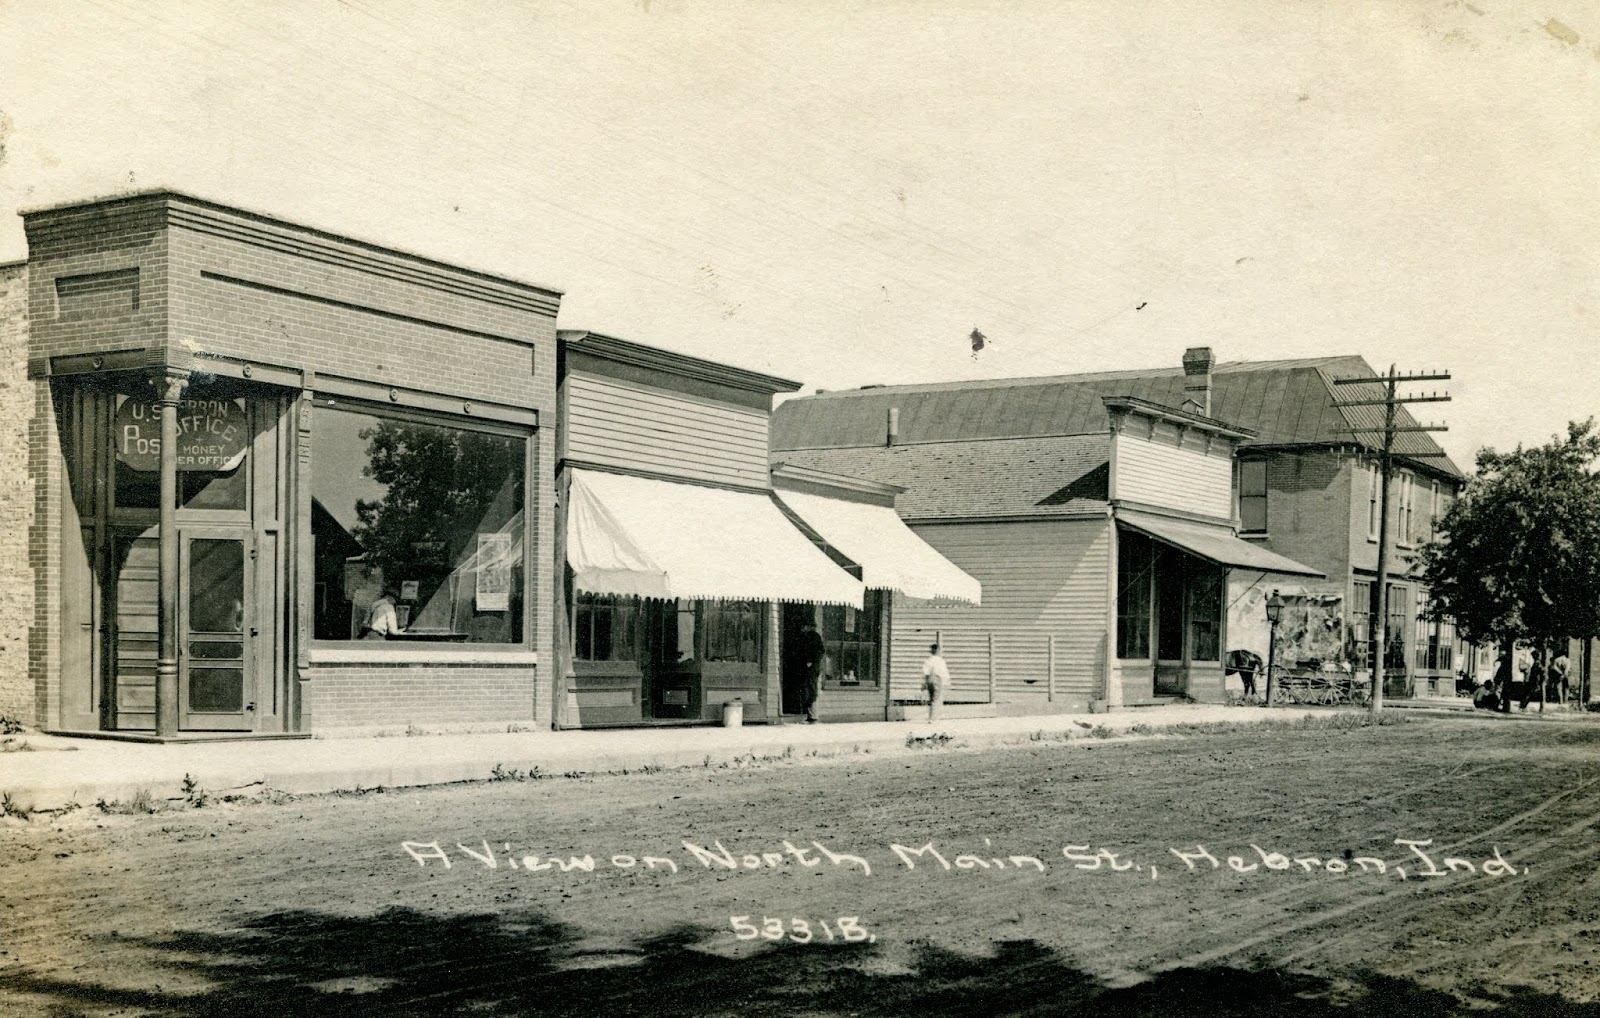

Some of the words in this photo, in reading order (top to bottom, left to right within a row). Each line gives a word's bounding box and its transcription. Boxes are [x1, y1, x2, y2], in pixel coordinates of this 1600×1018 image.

[123, 424, 161, 455] POS
[183, 444, 226, 455] MONEY
[197, 456, 232, 466] OFFIC
